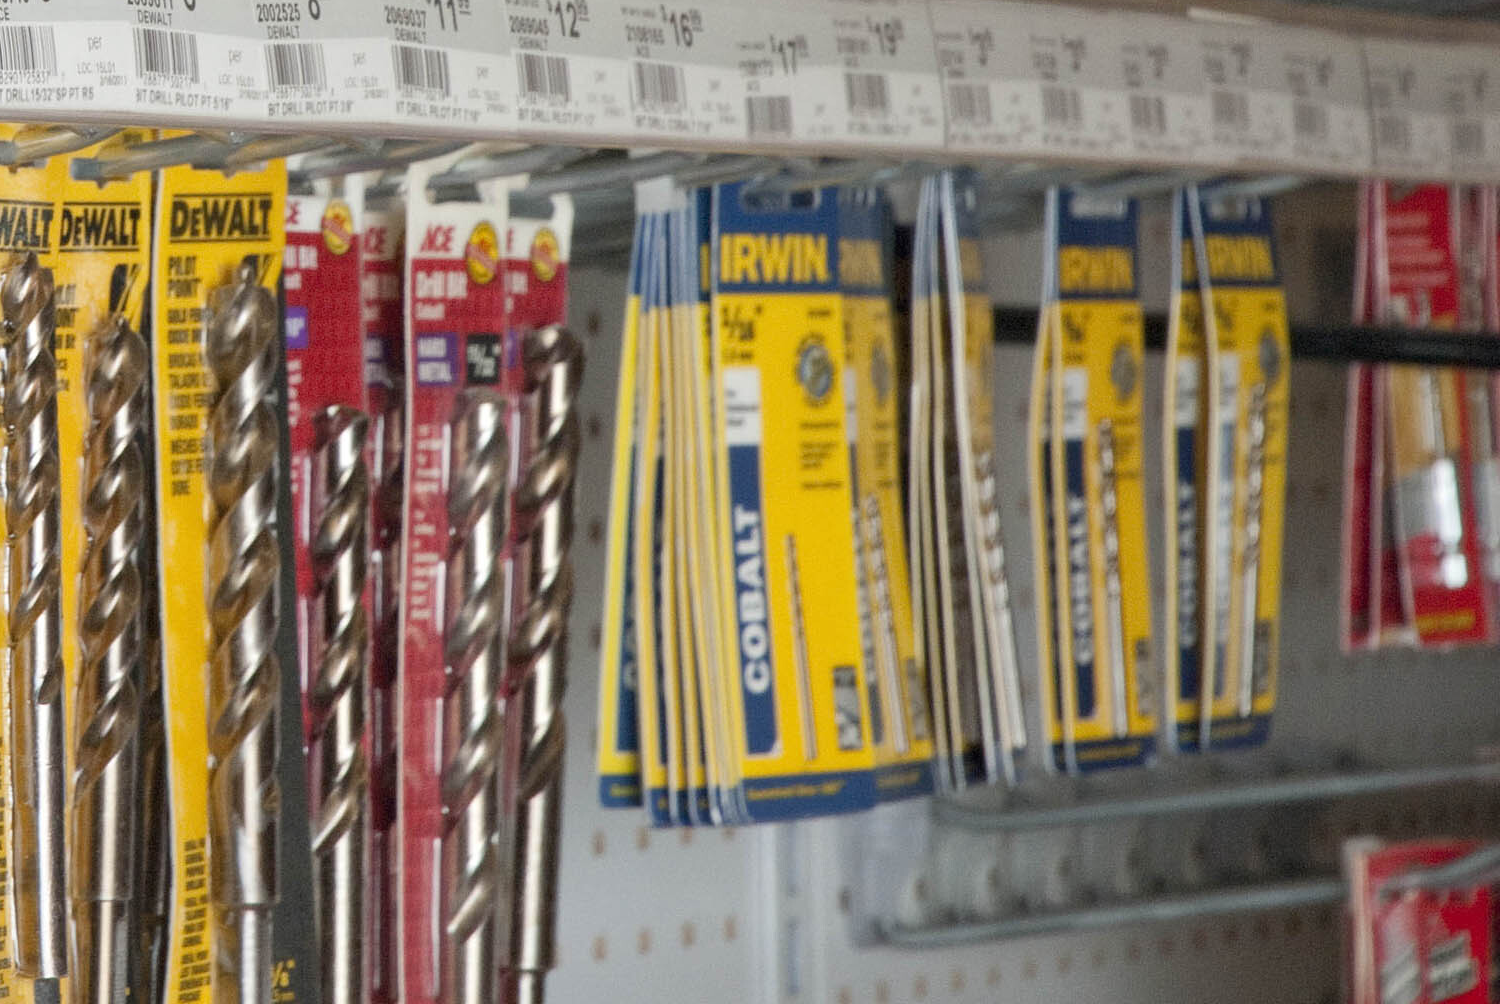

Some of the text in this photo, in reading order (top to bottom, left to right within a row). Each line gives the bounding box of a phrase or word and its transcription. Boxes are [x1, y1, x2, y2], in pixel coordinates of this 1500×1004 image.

[137, 9, 172, 26] DEWALT
[256, 3, 300, 23] 2002525
[267, 25, 300, 39] DEWALT
[394, 27, 427, 44] DEWALT
[59, 205, 141, 248] DEWALT
[170, 197, 273, 239] DEWALT
[719, 232, 830, 285] IRWIN
[735, 504, 773, 695] COBALT
